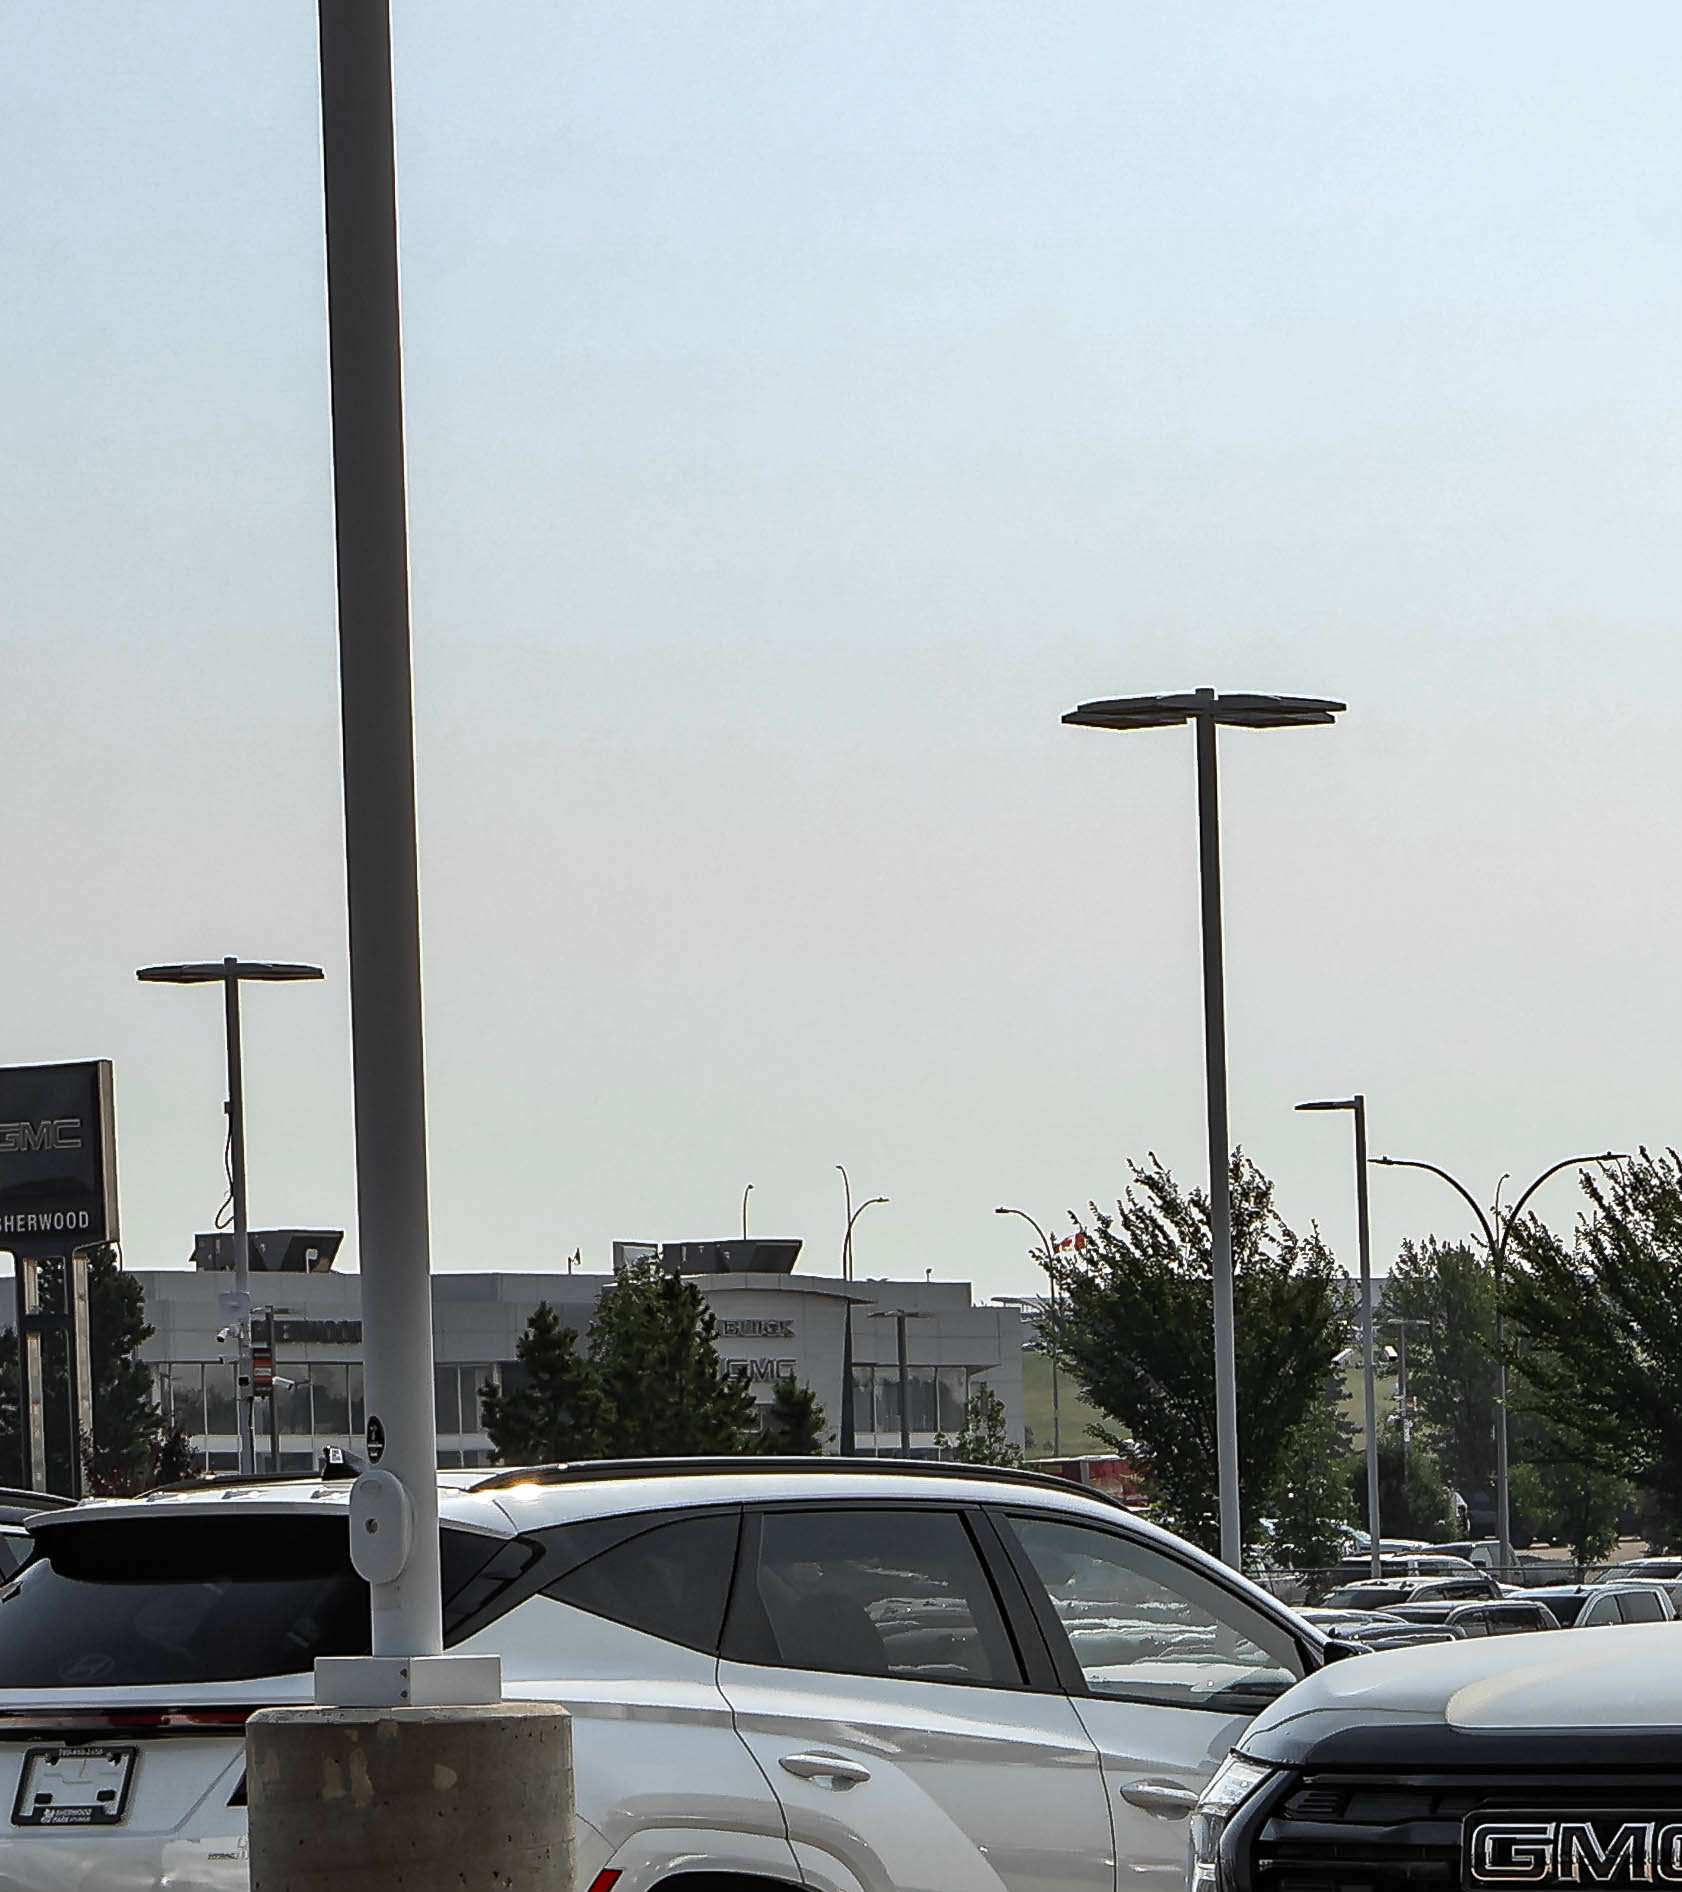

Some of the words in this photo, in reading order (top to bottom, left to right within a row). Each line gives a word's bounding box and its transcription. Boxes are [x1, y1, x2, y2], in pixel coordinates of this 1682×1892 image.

[0, 1211, 89, 1232] HERWOOD
[721, 1319, 797, 1338] BUICK
[722, 1359, 798, 1381] GMC
